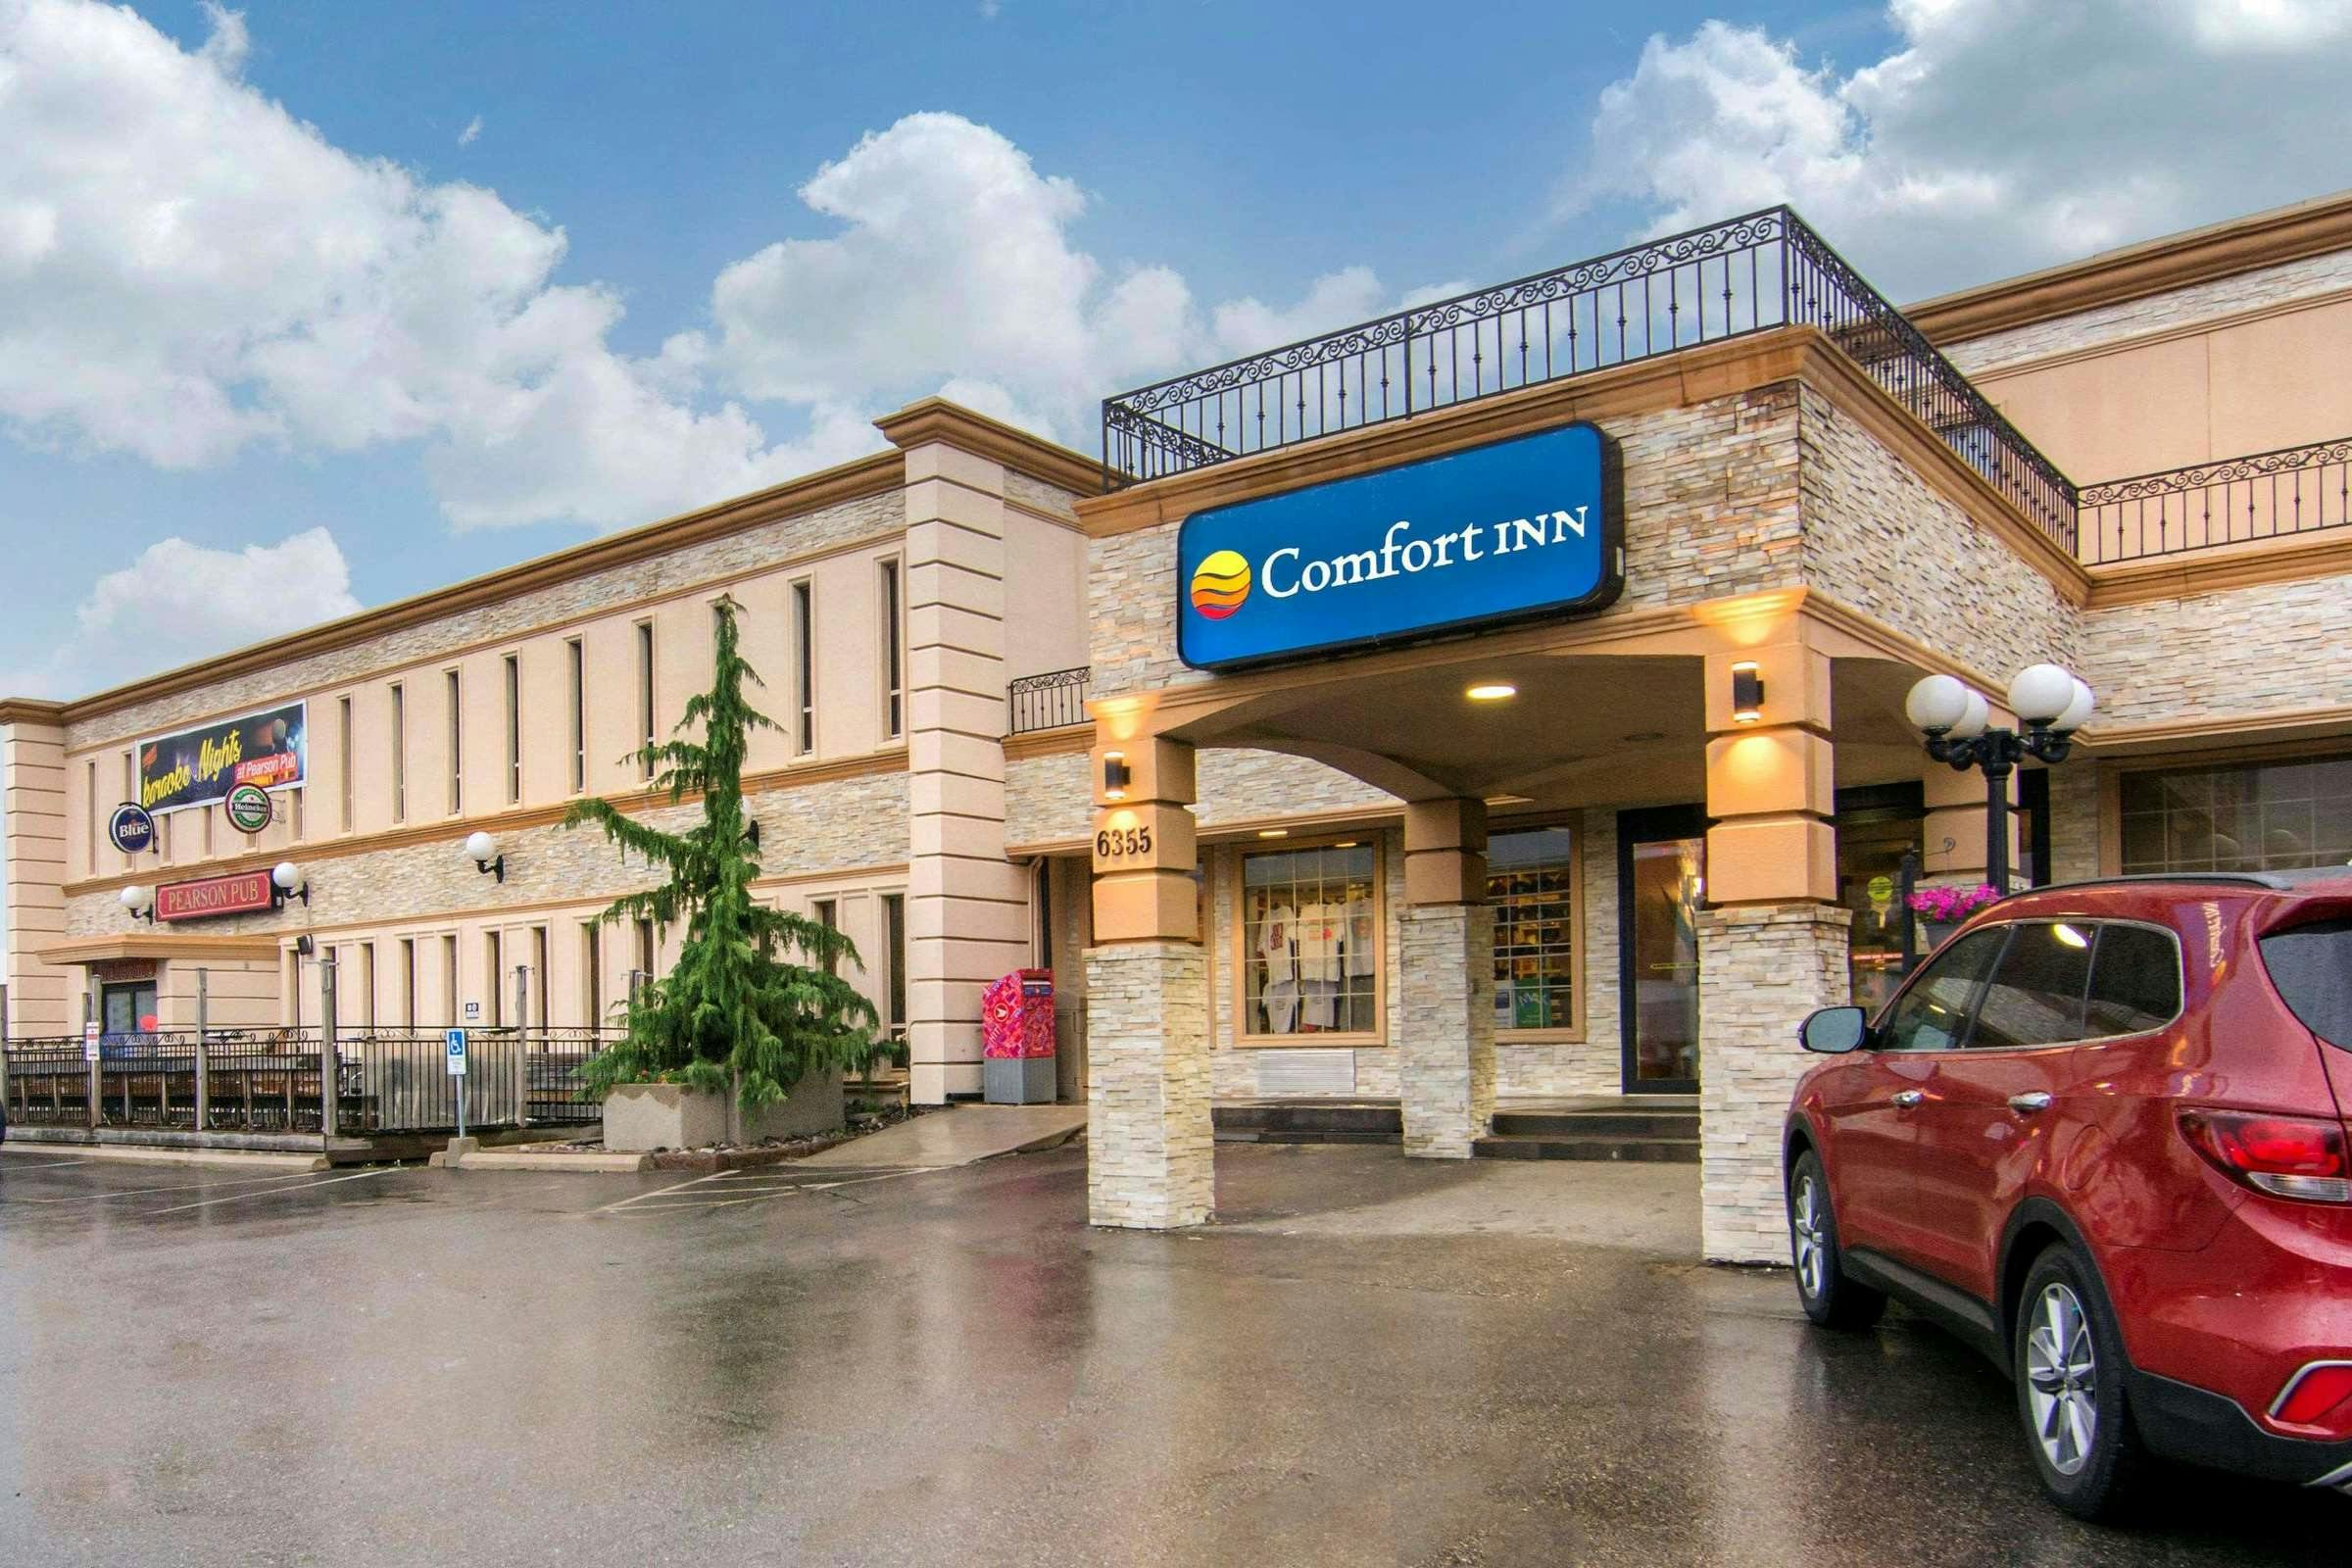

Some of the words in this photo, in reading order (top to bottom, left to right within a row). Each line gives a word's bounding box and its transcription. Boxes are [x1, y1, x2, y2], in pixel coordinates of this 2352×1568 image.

[1261, 520, 1489, 599] Comfort
[1493, 506, 1590, 556] INN
[197, 729, 242, 783] Nights
[236, 763, 245, 780] at
[247, 759, 278, 776] Pearson
[280, 753, 296, 769] Pub
[119, 822, 149, 838] Blue
[1097, 826, 1152, 857] 6355
[169, 884, 227, 911] PEARSON
[231, 880, 259, 904] PUB
